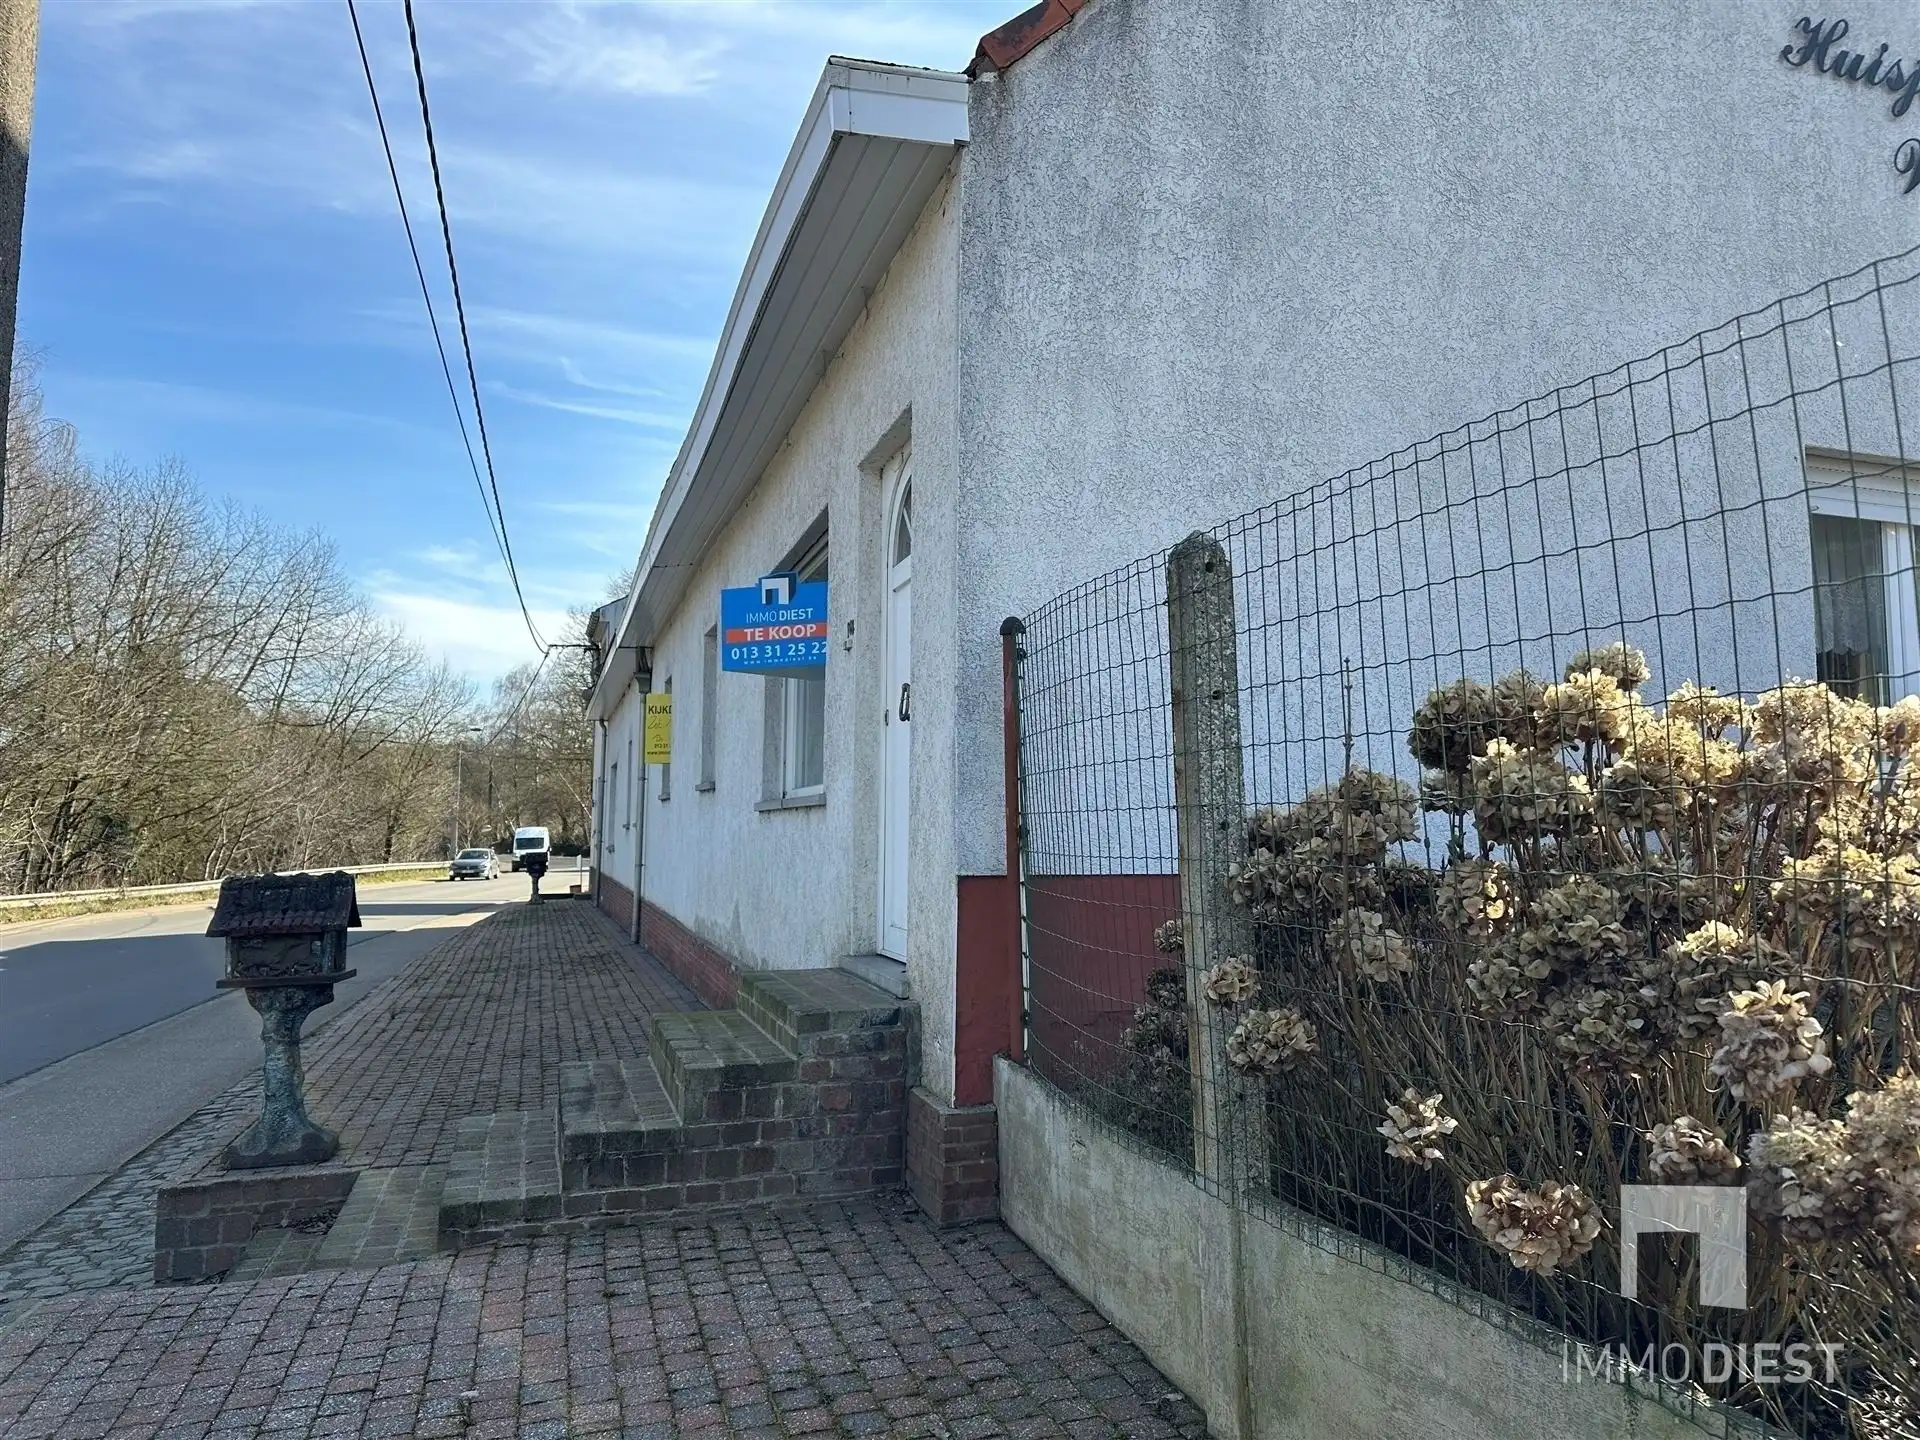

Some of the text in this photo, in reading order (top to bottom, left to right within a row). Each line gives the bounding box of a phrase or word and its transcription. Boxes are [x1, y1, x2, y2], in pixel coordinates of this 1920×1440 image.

[746, 608, 813, 623] IMMO DIEST
[744, 624, 817, 641] TE KOOP
[731, 647, 759, 660] 013
[764, 645, 781, 657] 31
[788, 643, 806, 655] 25
